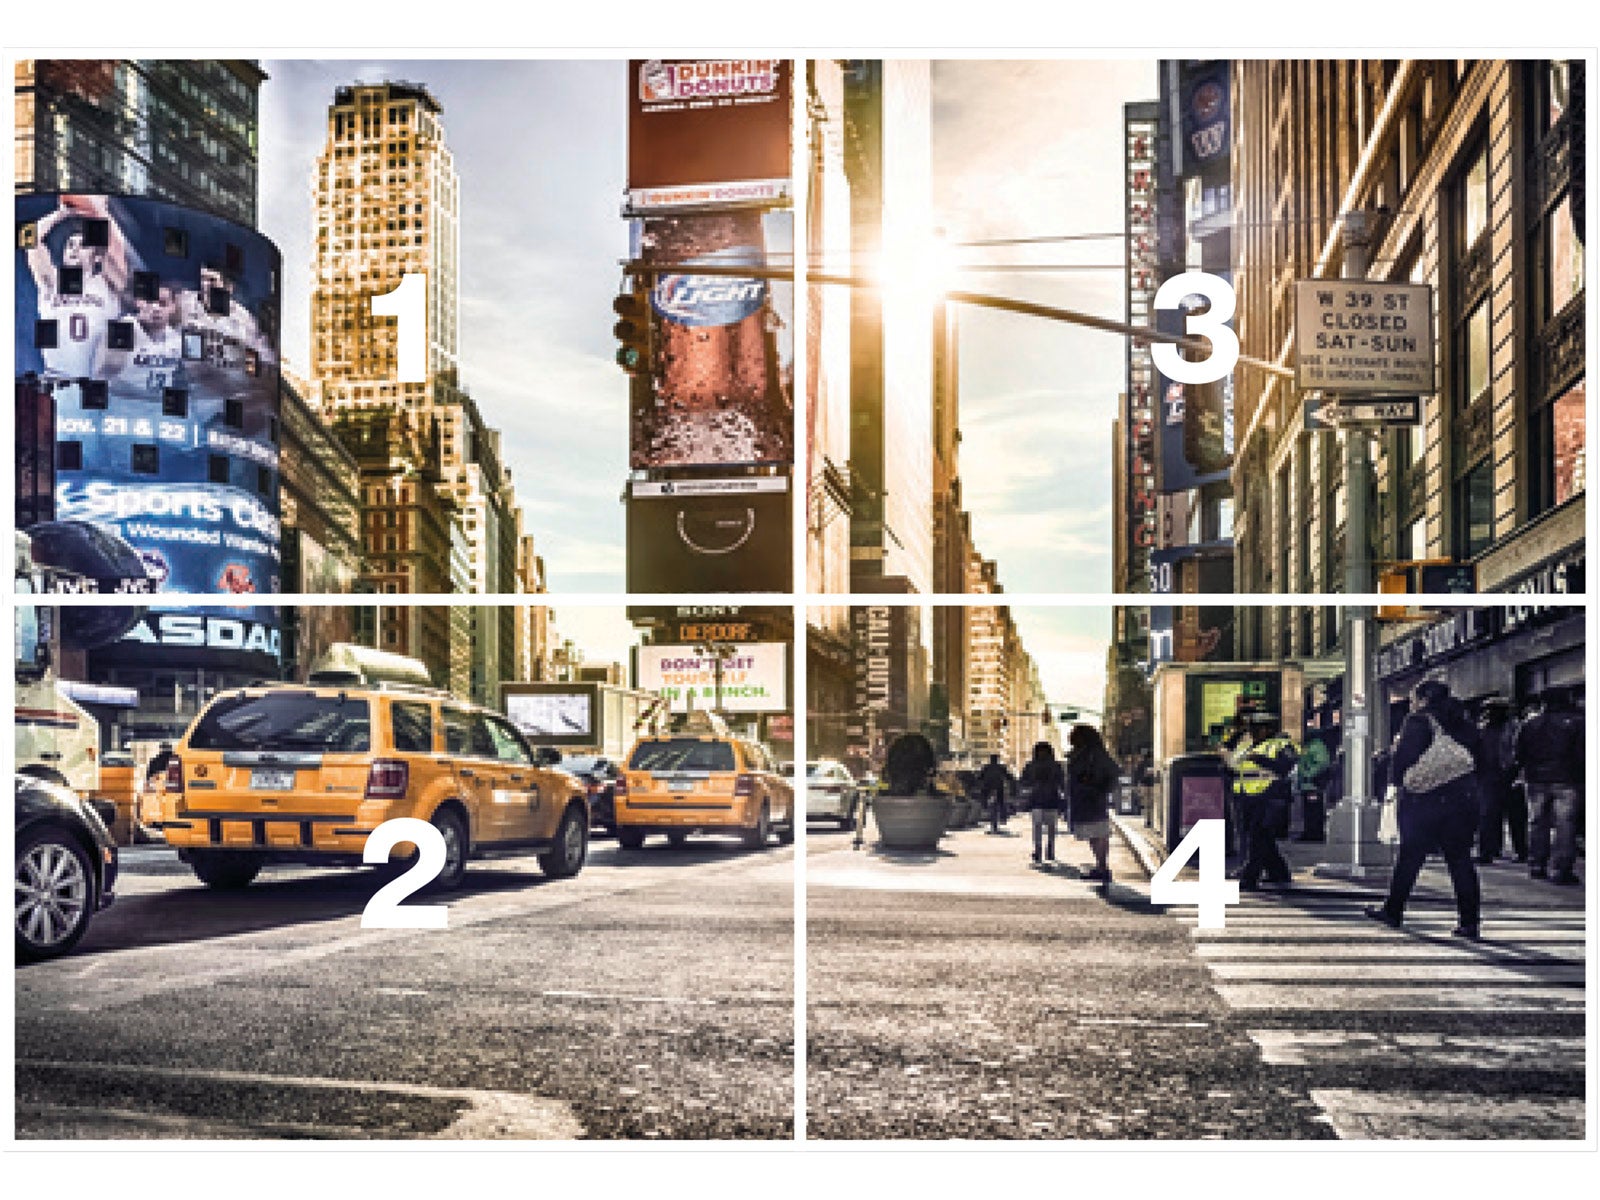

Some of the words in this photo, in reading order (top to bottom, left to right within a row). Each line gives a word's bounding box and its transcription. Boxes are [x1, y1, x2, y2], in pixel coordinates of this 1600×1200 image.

[679, 76, 772, 97] DONUTS
[1316, 291, 1333, 307] W
[1345, 291, 1372, 308] 39
[1383, 293, 1409, 310] ST
[1321, 313, 1407, 332] CLOSED
[133, 419, 154, 437] &
[87, 480, 224, 522] Sports
[127, 521, 221, 545] Wounded
